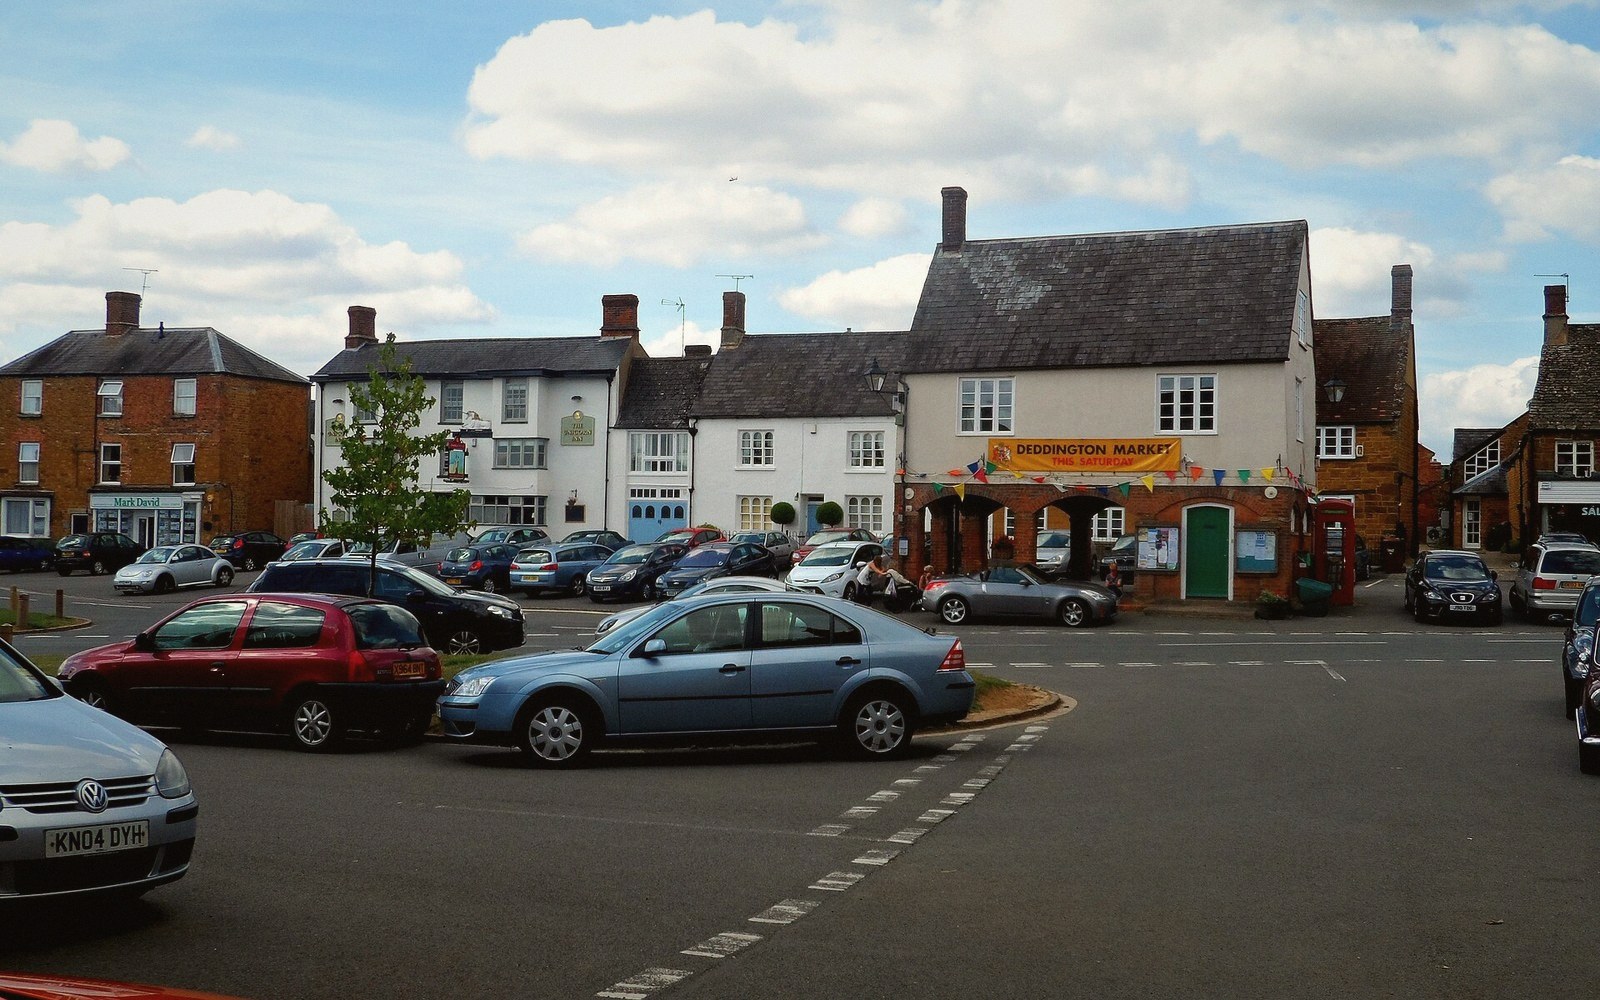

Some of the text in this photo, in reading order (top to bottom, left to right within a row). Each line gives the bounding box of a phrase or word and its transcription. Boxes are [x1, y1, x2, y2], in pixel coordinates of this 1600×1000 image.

[1016, 443, 1172, 455] DEDDINGTON MARKET
[1052, 457, 1135, 466] THIS SATURDAY
[114, 498, 137, 507] Mark
[137, 498, 160, 507] David
[55, 825, 142, 853] KN04 DYH
